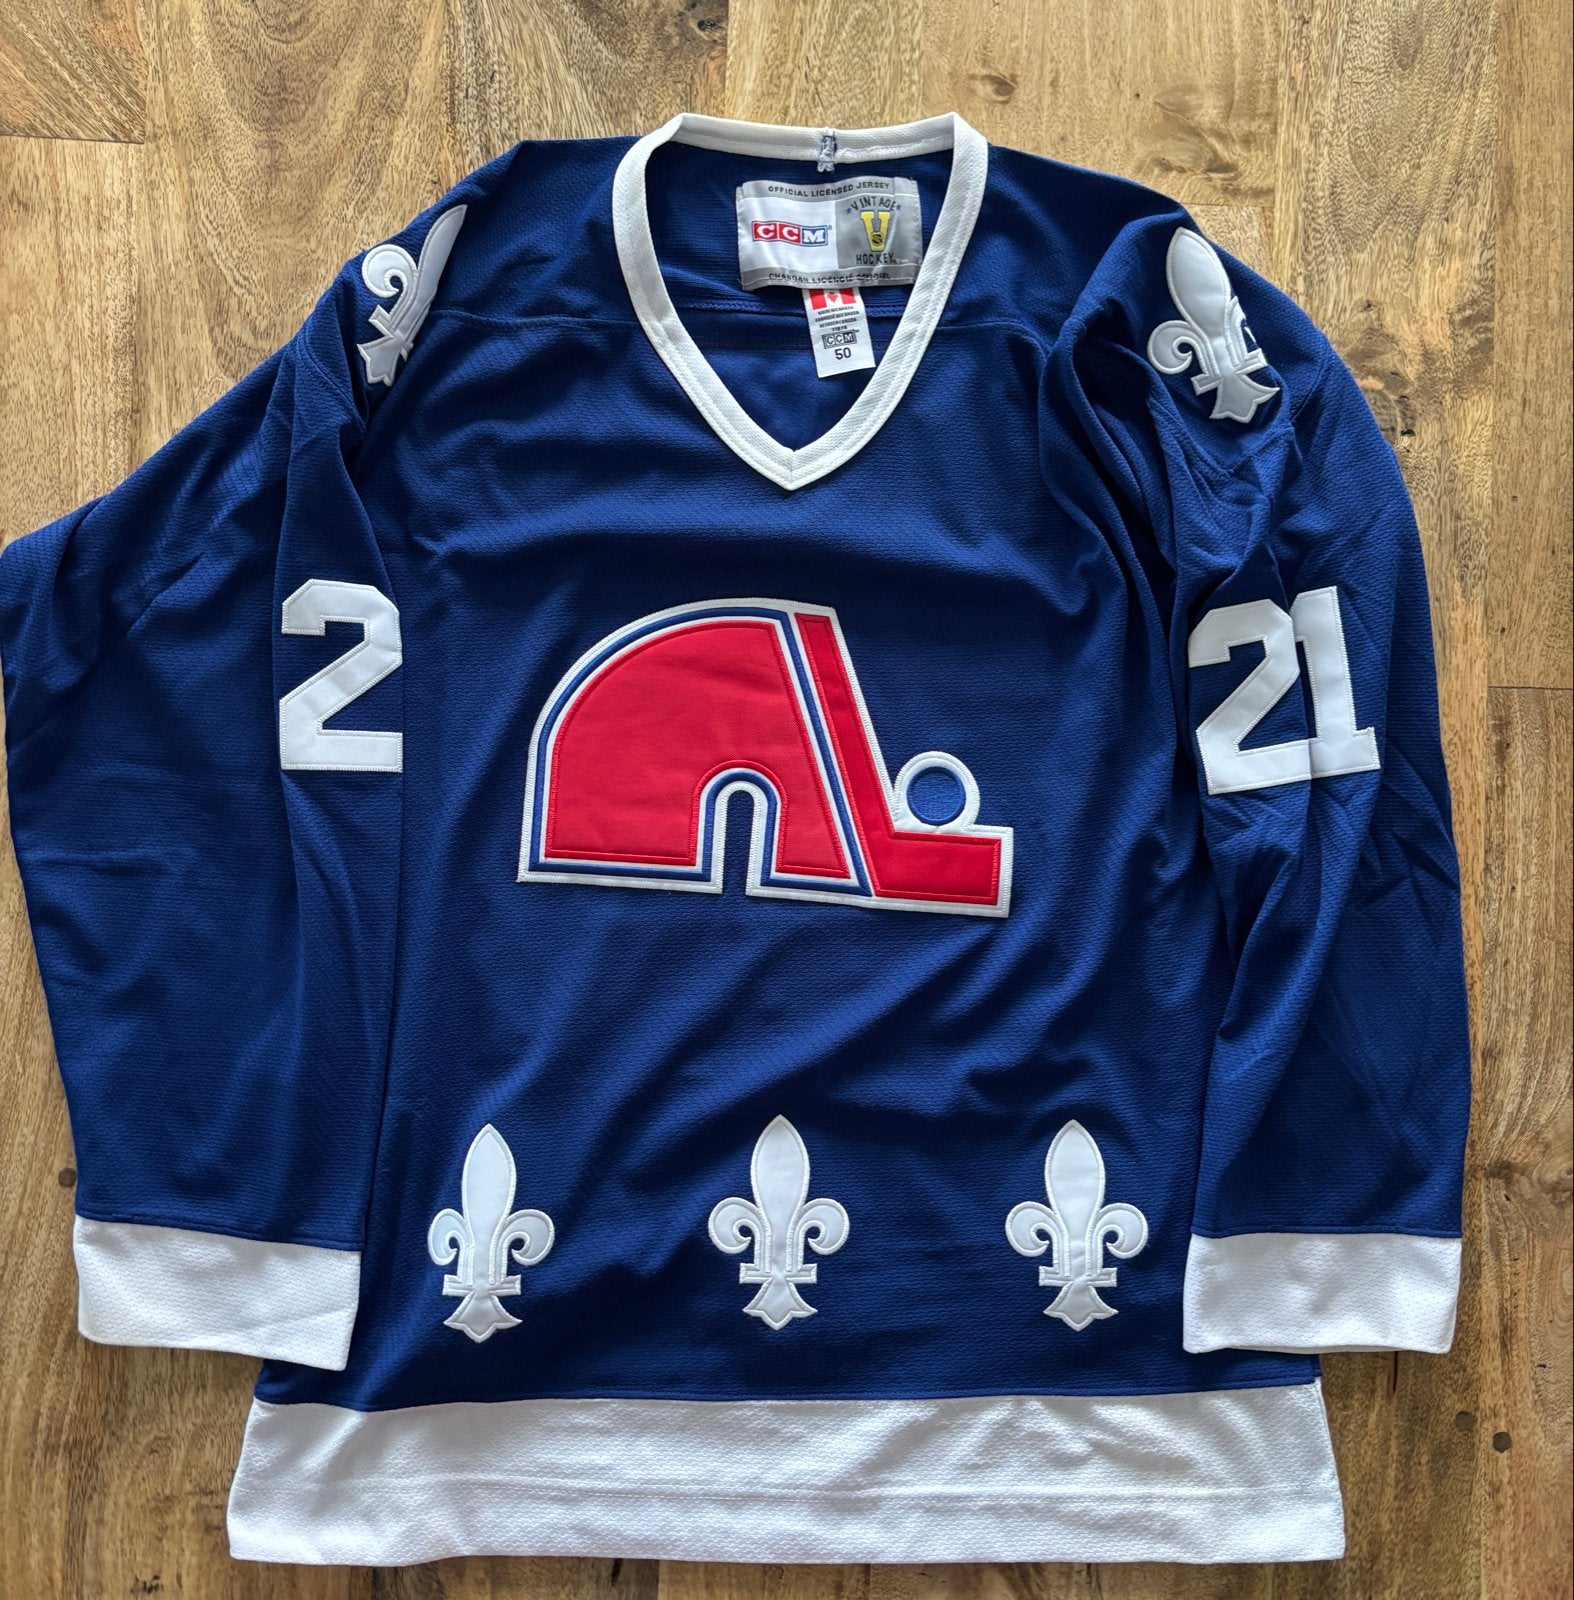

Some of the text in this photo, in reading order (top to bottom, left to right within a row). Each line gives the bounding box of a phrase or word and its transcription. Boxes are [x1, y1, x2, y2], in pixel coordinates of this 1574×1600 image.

[768, 181, 890, 197] OFFICIAL LICENSED JERSEY
[851, 196, 896, 211] VINTAGE
[756, 223, 826, 245] CCM
[856, 252, 894, 264] HOCKEY
[826, 331, 854, 345] CCM
[835, 347, 852, 360] 50
[279, 578, 403, 773] 2
[1187, 585, 1381, 795] 21
